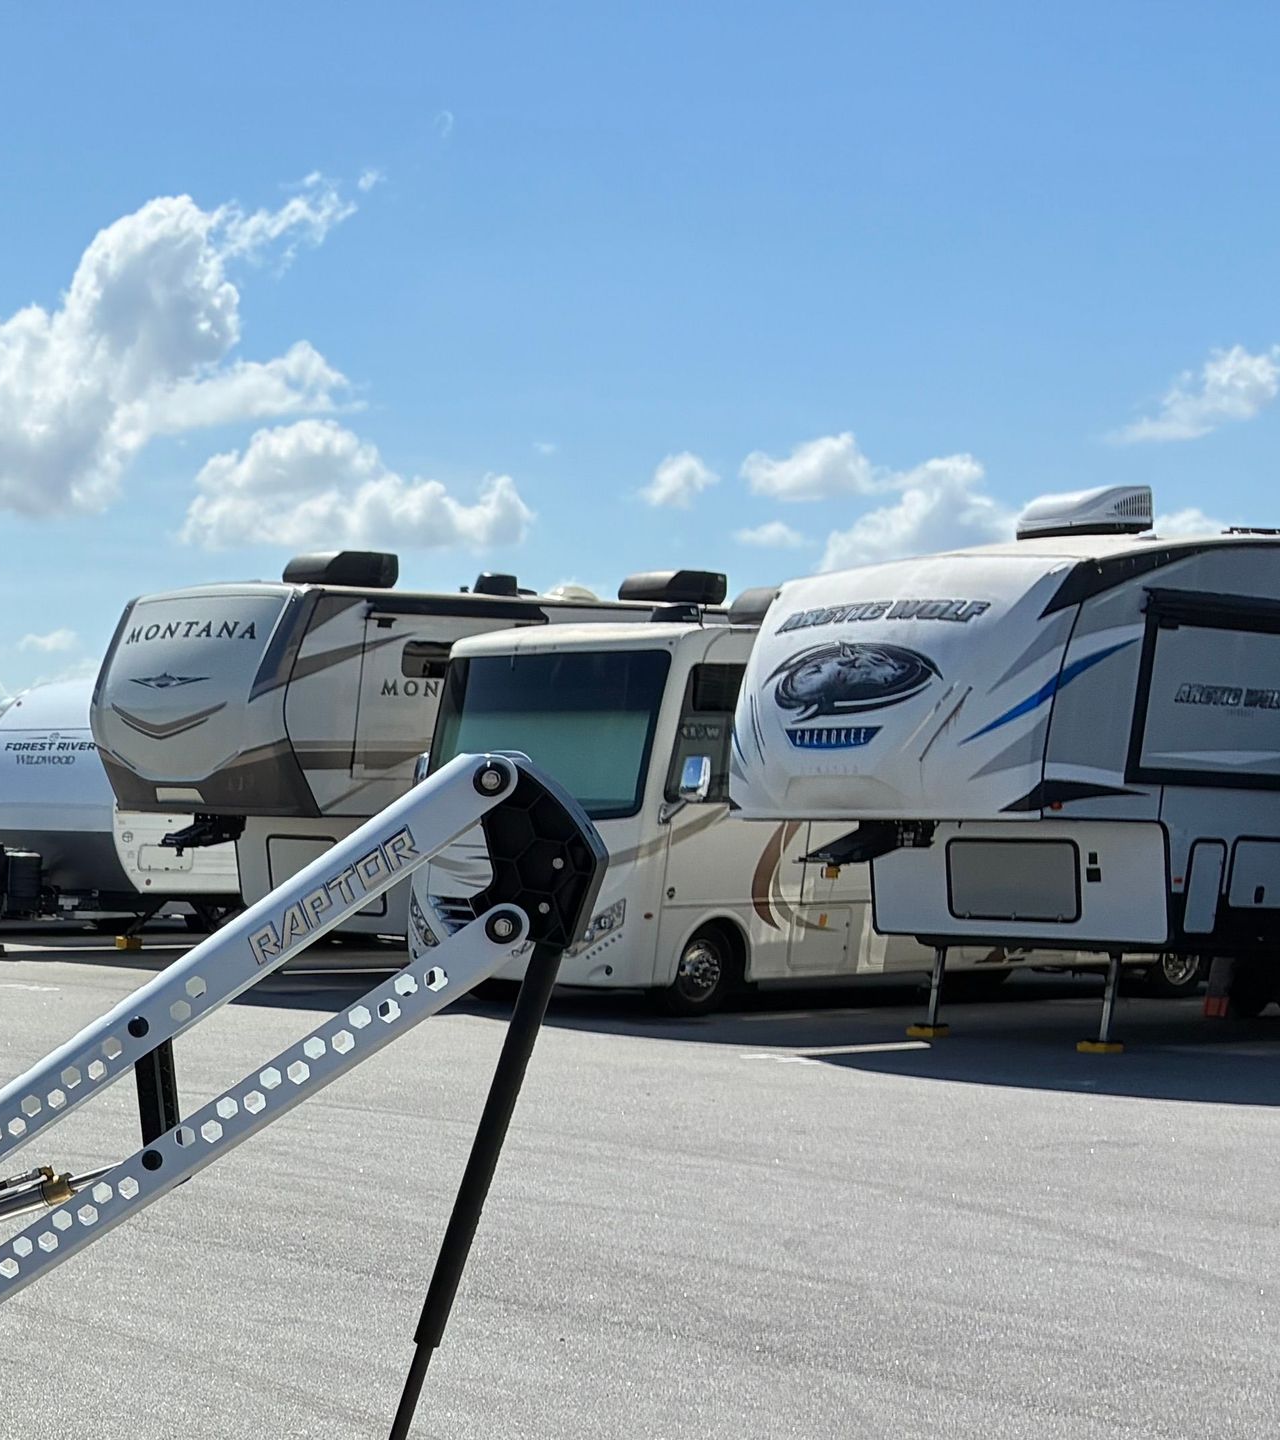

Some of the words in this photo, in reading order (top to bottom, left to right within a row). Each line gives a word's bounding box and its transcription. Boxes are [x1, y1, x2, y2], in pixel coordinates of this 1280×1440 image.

[775, 601, 891, 635] ARCTIC
[888, 599, 991, 622] WOLF
[126, 620, 257, 645] MONTANA
[380, 678, 440, 698] MON
[5, 742, 56, 751] FOREST
[56, 741, 97, 751] RIVER
[795, 729, 868, 746] CHEROKEE
[16, 754, 76, 766] WILDWOOD
[248, 823, 420, 966] RAPTOR
